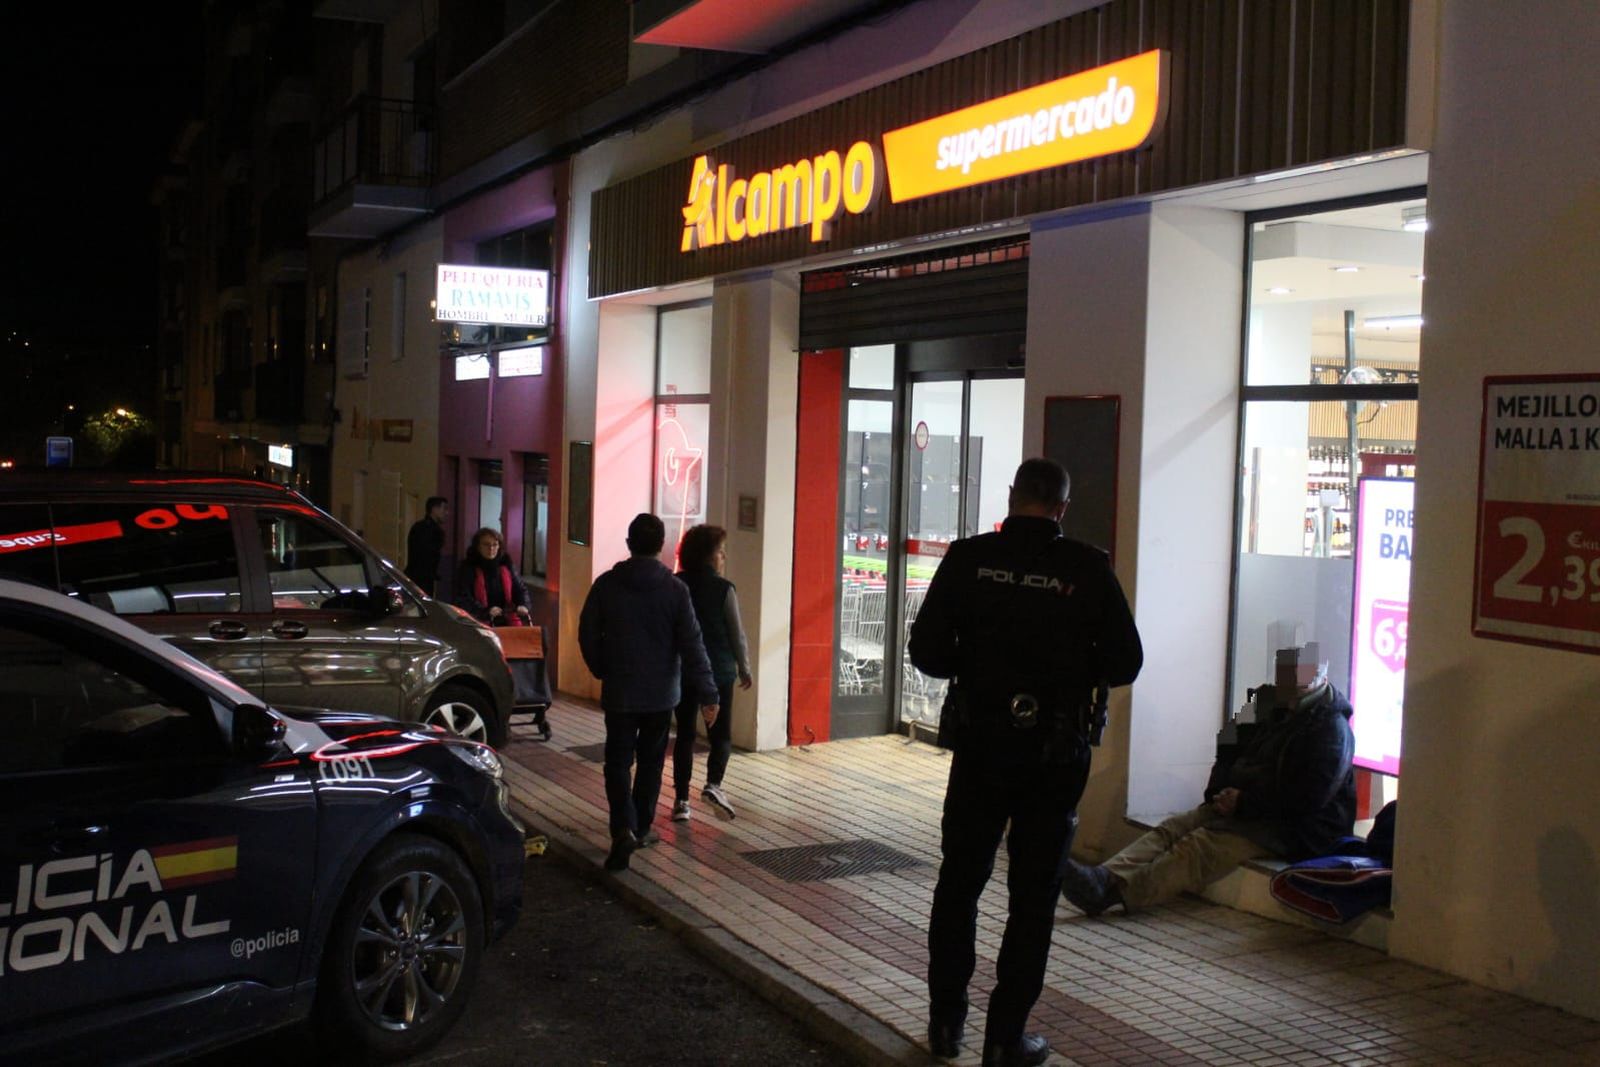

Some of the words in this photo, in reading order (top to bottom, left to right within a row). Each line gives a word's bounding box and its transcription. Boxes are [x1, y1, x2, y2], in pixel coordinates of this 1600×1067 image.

[936, 77, 1136, 174] supermercado
[681, 140, 875, 252] Alcampo
[442, 271, 544, 288] PELUQUERIA
[438, 309, 489, 321] HOMBRE
[1497, 394, 1600, 418] MEJILLO
[1495, 427, 1563, 450] MALLA
[1567, 427, 1580, 450] 1
[977, 567, 1062, 592] POLICIA
[331, 755, 375, 783] 091
[0, 850, 163, 916] ICÍA
[230, 926, 300, 959] @policia
